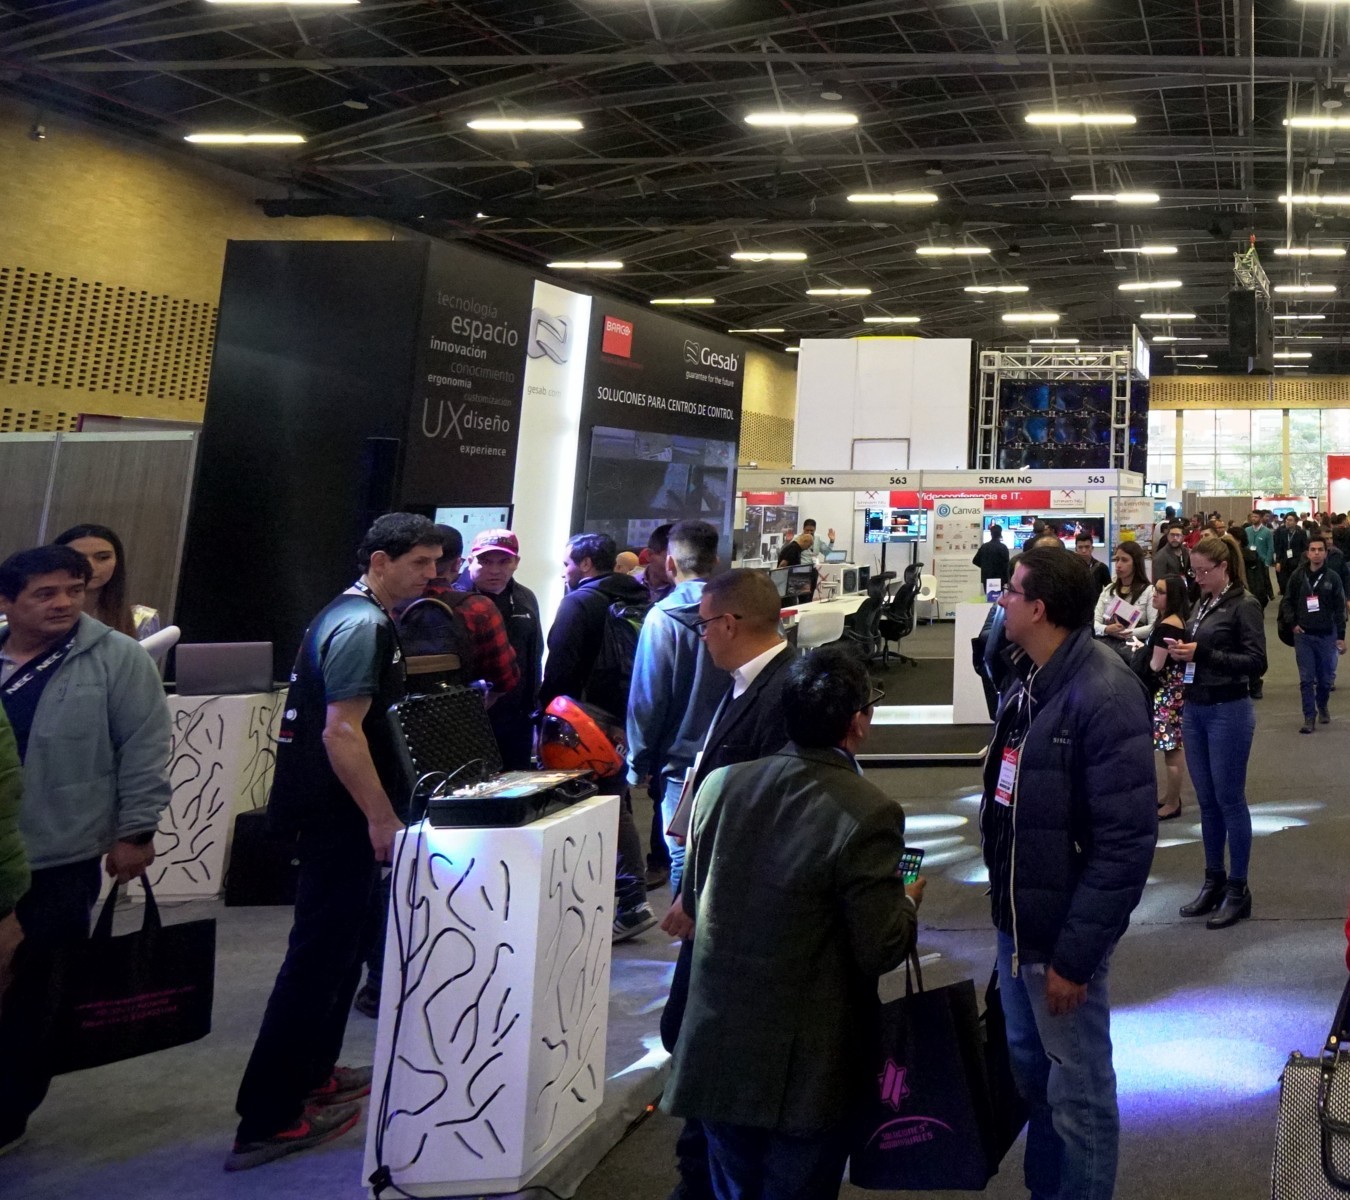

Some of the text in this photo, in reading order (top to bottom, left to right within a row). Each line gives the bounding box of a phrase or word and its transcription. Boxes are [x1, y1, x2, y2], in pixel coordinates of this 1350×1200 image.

[451, 315, 518, 346] espacio
[430, 335, 487, 359] innovación
[700, 347, 738, 372] Gesab
[597, 386, 734, 420] SOLUCIONES PARA CENTROS DE CONTROL
[422, 398, 466, 440] UX
[463, 410, 510, 432] diseño
[459, 445, 507, 457] experience
[780, 477, 834, 485] STREAM NG
[889, 477, 907, 485] 563
[978, 476, 1032, 484] STREAM NG
[1087, 476, 1105, 484] 563
[952, 506, 981, 515] Canvas
[34, 650, 64, 672] NEC
[5, 672, 35, 695] NEC
